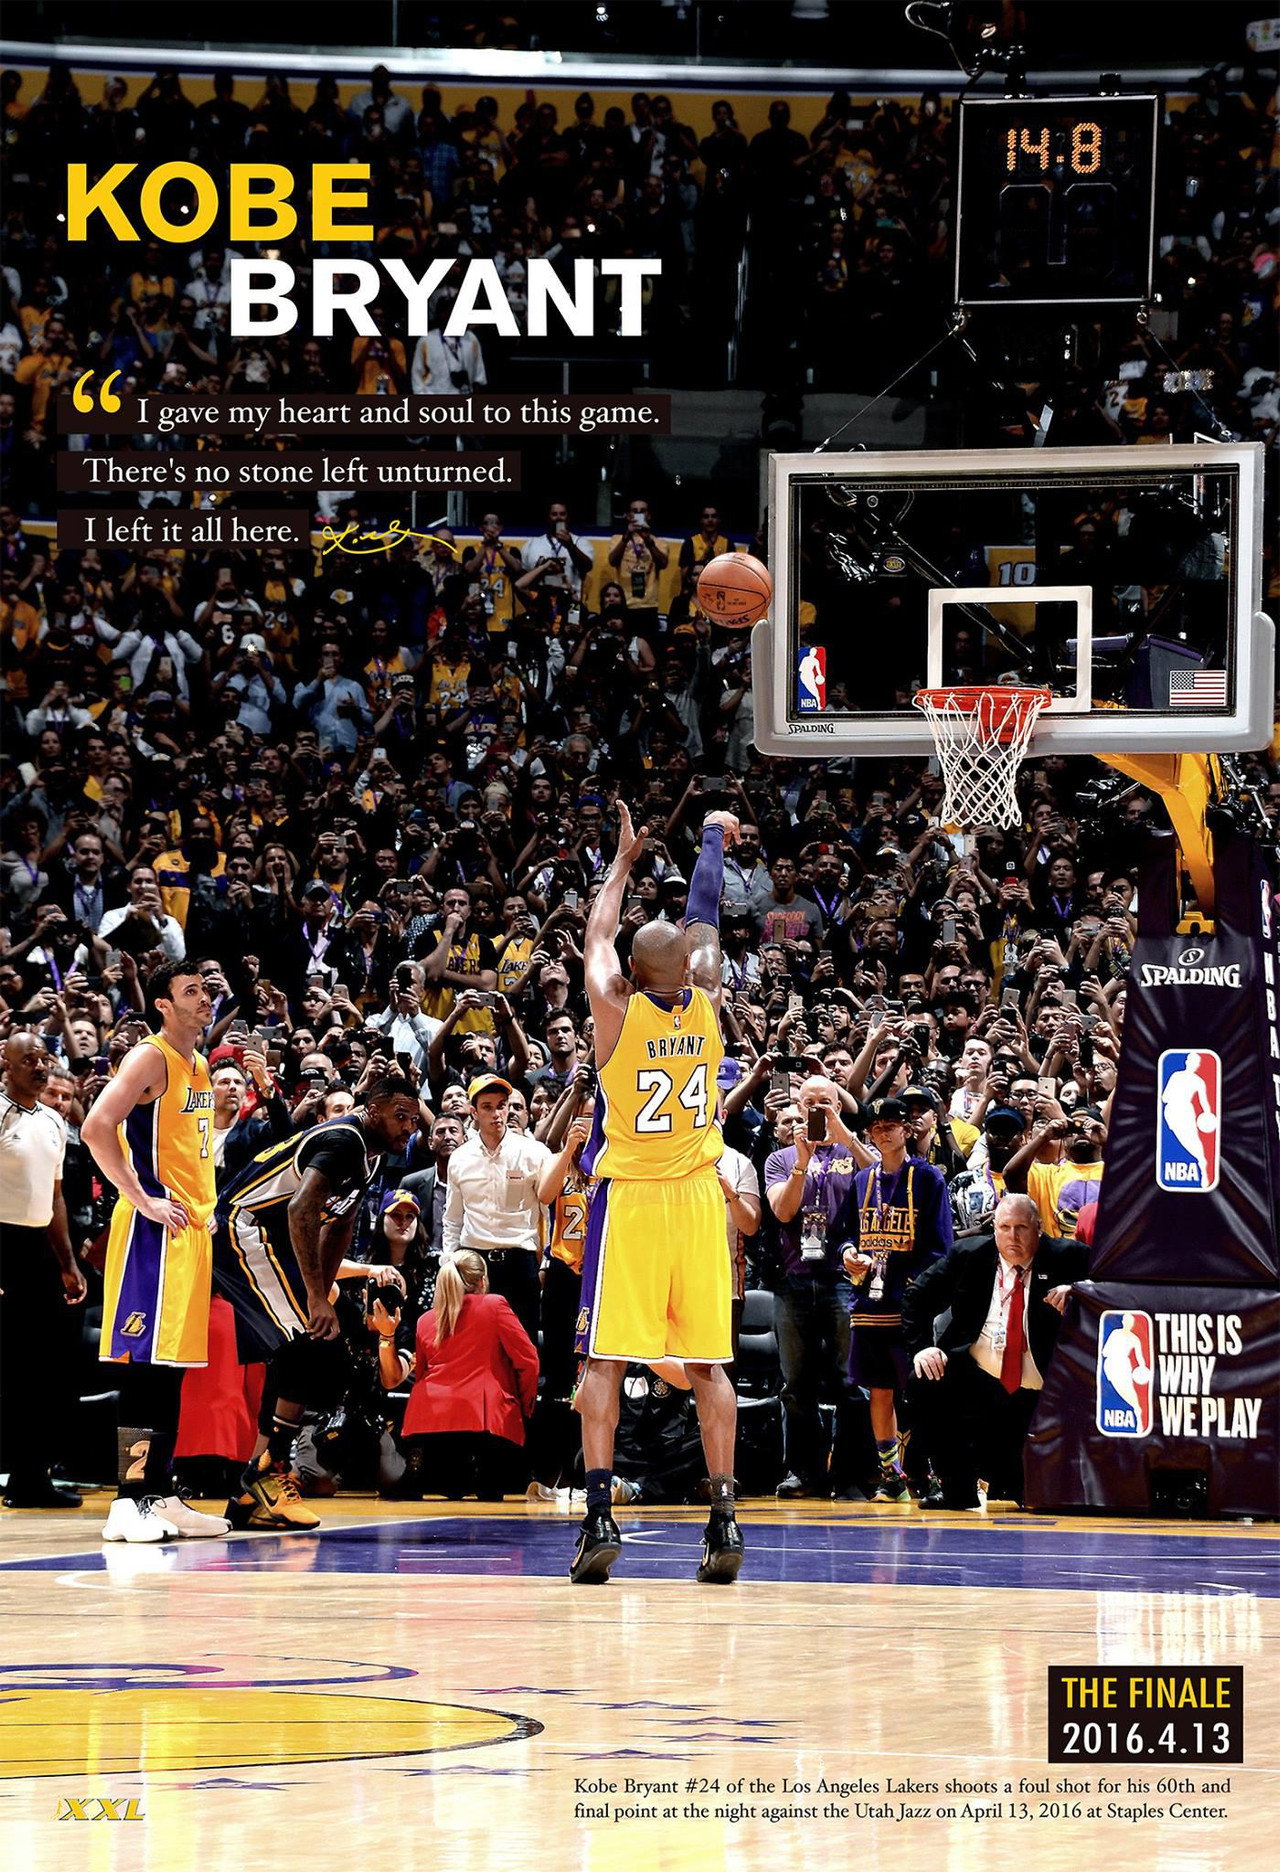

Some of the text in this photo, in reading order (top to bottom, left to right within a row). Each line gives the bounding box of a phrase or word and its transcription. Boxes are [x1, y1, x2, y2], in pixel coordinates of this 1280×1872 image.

[1006, 122, 1102, 174] 14.8
[800, 698, 818, 709] NBA
[788, 723, 835, 735] SPALDING
[1140, 962, 1242, 989] SPALDING
[645, 1035, 706, 1060] BRYANT
[634, 1063, 708, 1134] 24
[197, 1117, 210, 1159] 7
[1164, 1162, 1200, 1182] NBA
[1154, 1313, 1243, 1356] THIS IS
[1157, 1355, 1217, 1395] WHY
[1104, 1409, 1137, 1428] NBA
[1159, 1396, 1262, 1439] WE PLAY
